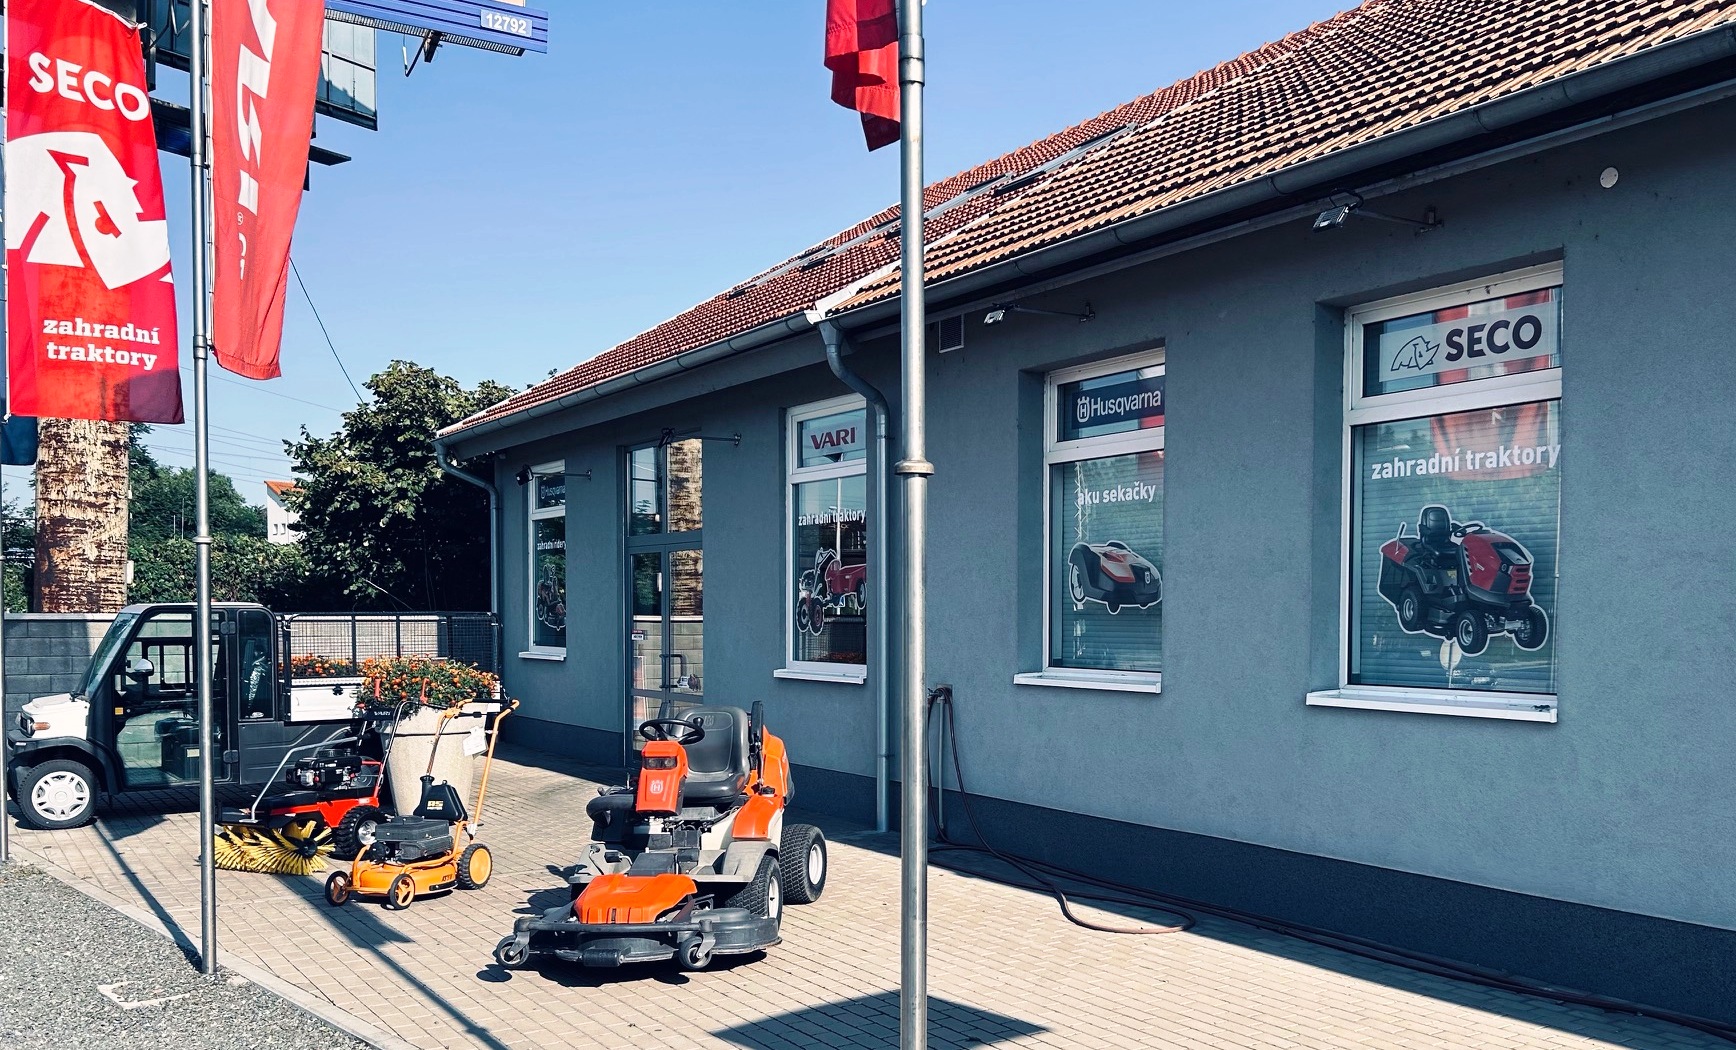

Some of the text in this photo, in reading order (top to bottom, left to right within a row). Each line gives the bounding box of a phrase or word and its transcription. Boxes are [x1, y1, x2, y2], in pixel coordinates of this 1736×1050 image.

[486, 13, 527, 35] 12792
[28, 51, 150, 122] SECO
[42, 317, 160, 345] zahradní
[1444, 314, 1542, 362] SECO
[46, 342, 158, 371] traktory
[1091, 390, 1161, 417] Husqvarna
[810, 426, 856, 450] VARI
[1371, 444, 1561, 480] zahradní traktory
[1077, 481, 1157, 506] aku sekačky
